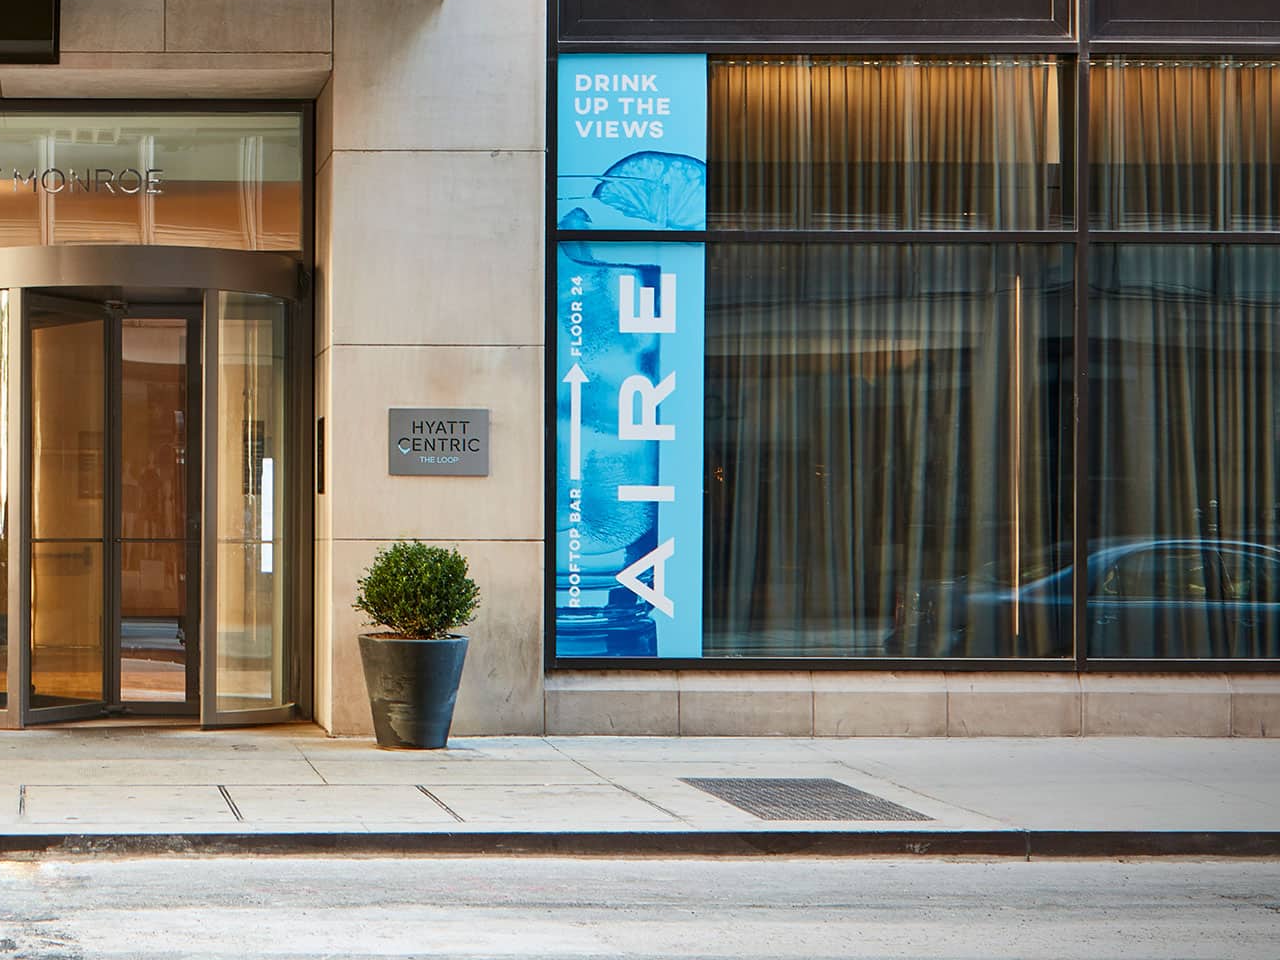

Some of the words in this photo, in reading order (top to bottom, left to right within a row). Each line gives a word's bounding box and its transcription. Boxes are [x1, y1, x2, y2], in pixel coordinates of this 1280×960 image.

[575, 73, 658, 92] DRINK
[574, 97, 609, 116] UP
[618, 97, 671, 116] THE
[575, 120, 664, 139] VIEWS
[12, 167, 164, 194] MONROE
[571, 275, 583, 295] 24
[570, 301, 583, 357] FLOOR
[412, 420, 471, 435] HYATT
[397, 437, 480, 455] CENTRIC
[615, 272, 677, 620] AIRE
[419, 456, 435, 464] THE
[436, 456, 460, 464] LOOP
[569, 488, 582, 522] BAR
[568, 528, 581, 608] ROOFTOP
